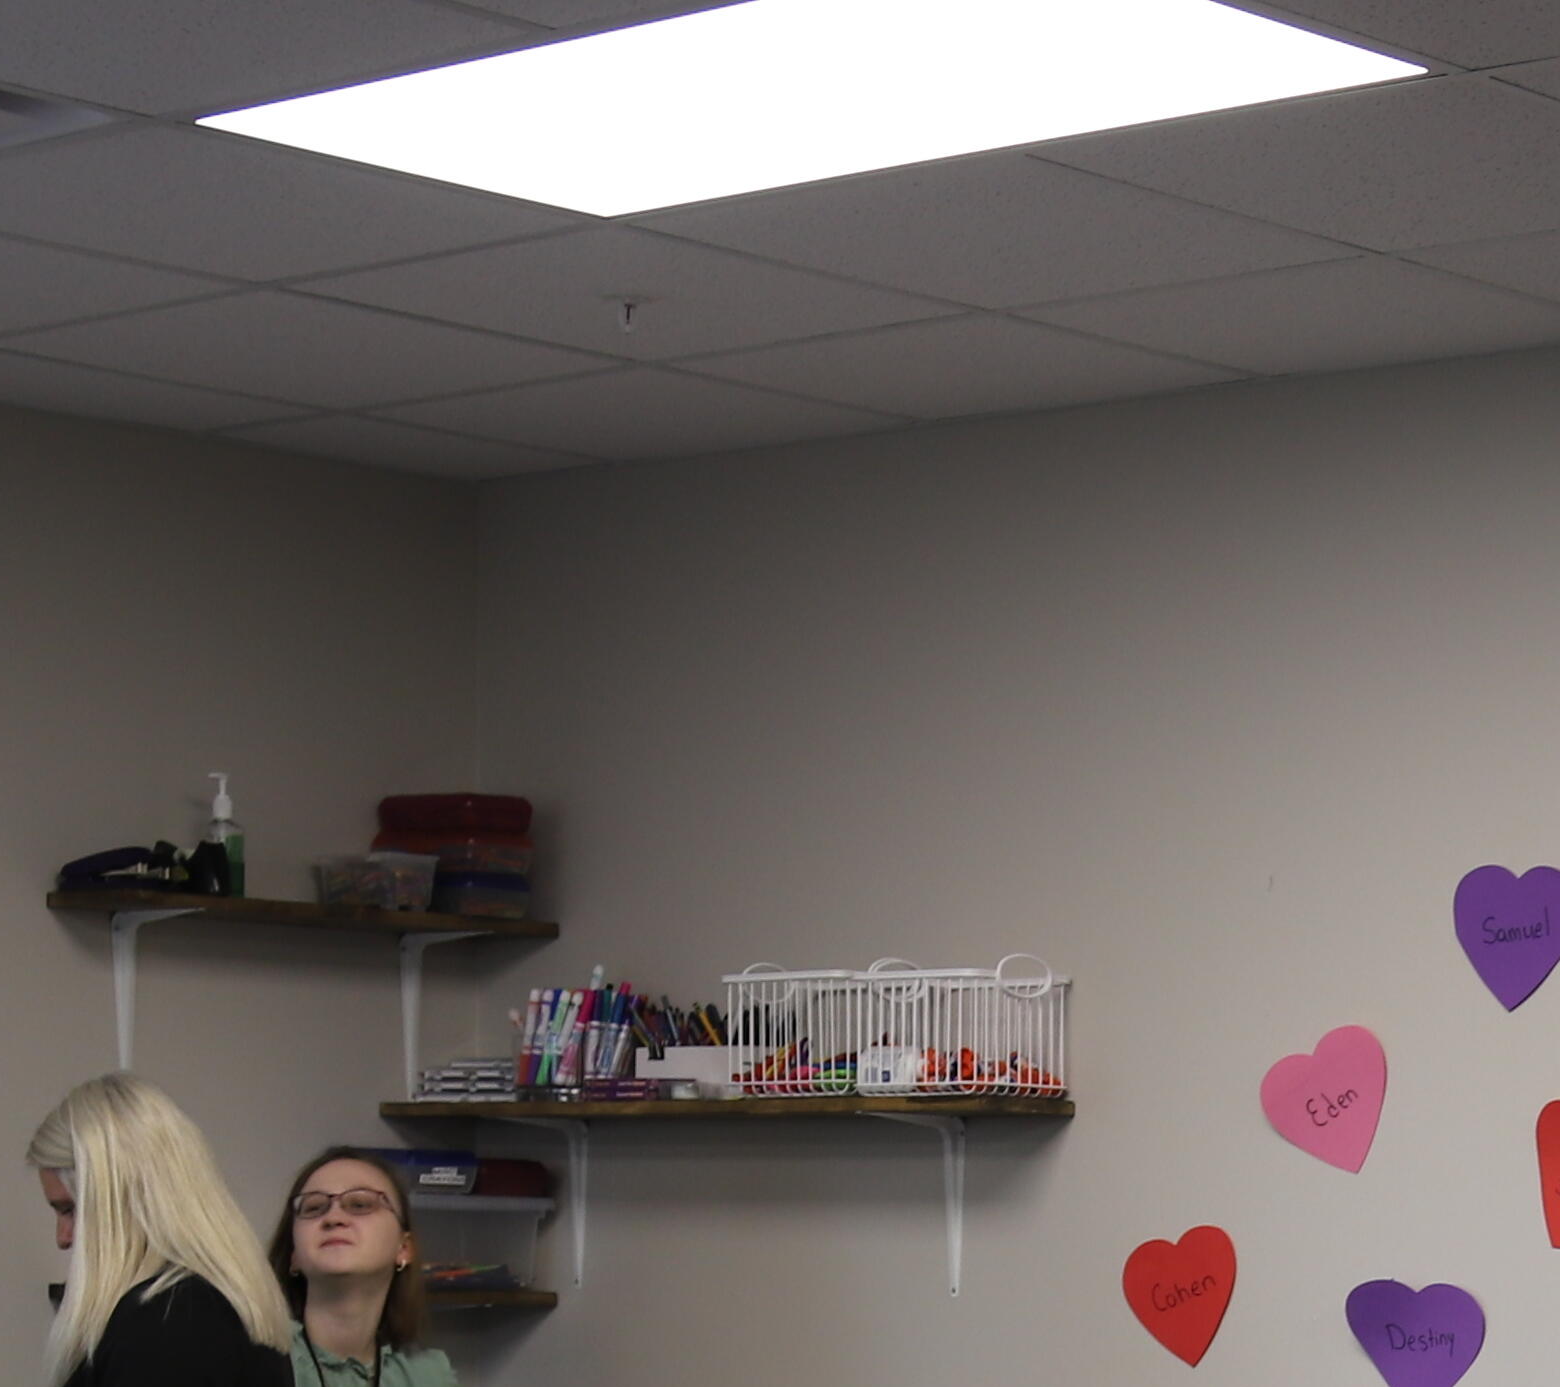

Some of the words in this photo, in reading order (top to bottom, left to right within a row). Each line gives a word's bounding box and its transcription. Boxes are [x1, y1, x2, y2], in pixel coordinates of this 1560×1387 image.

[1481, 907, 1551, 947] Samuel
[1305, 1086, 1360, 1130] Eden
[1151, 1272, 1217, 1312] Cohen
[1385, 1323, 1456, 1356] Destiny
